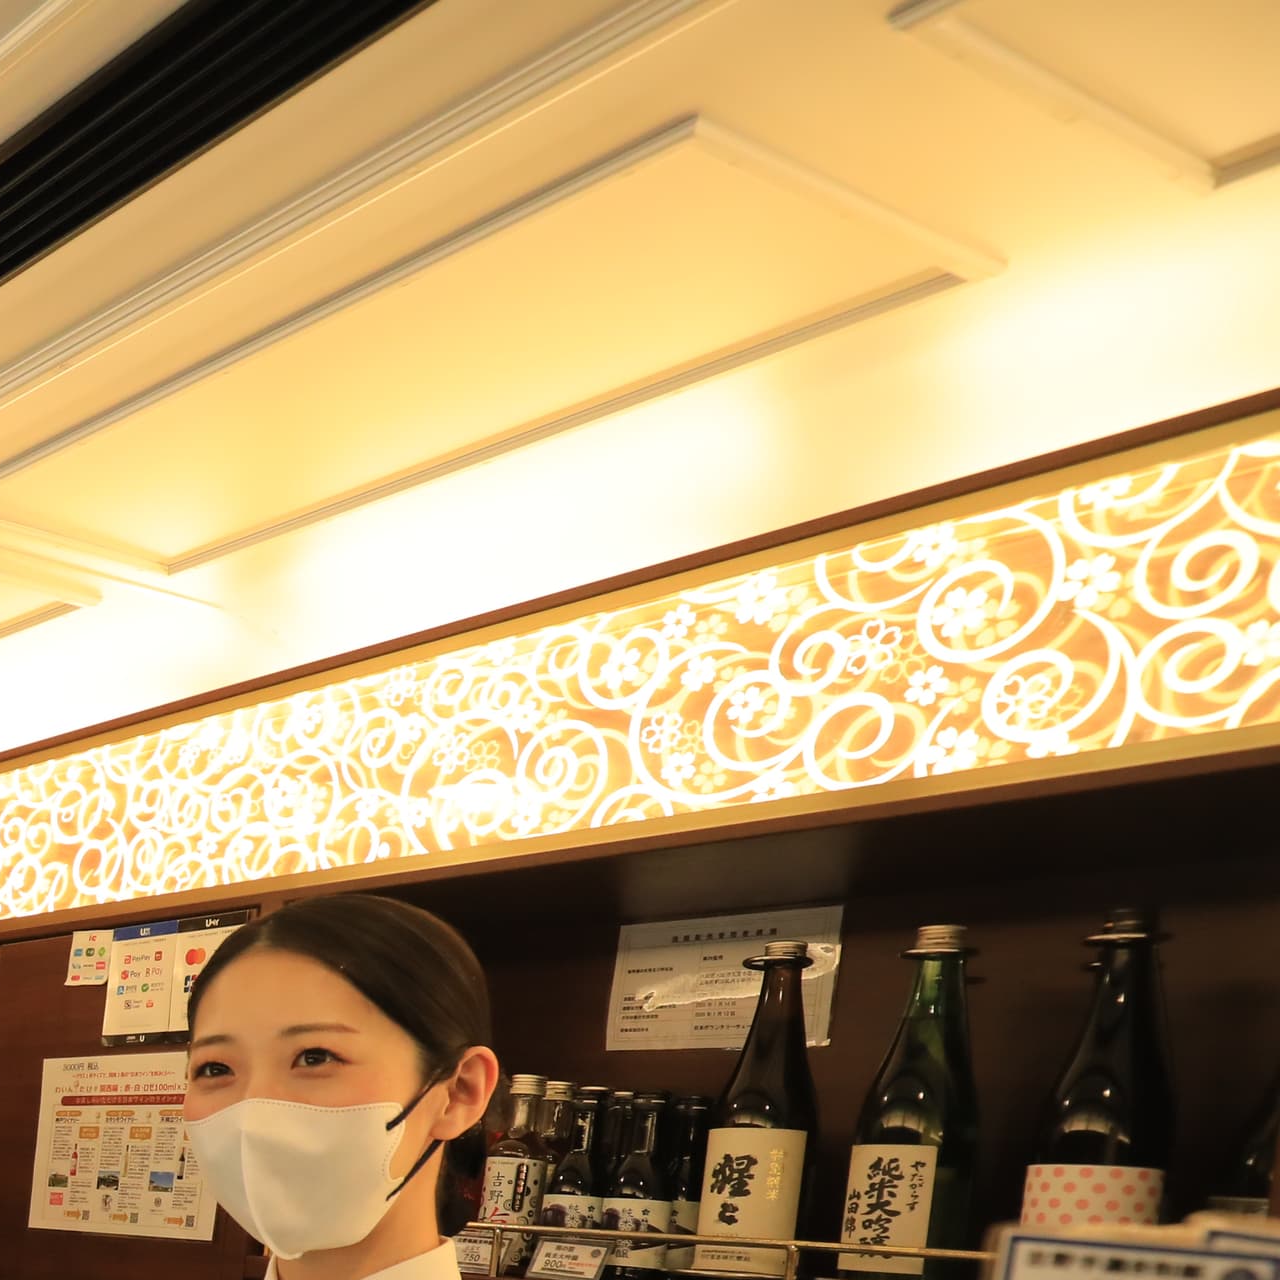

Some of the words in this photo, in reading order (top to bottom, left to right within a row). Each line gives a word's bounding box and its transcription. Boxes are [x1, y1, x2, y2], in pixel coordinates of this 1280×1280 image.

[905, 1160, 927, 1213] やたがらす
